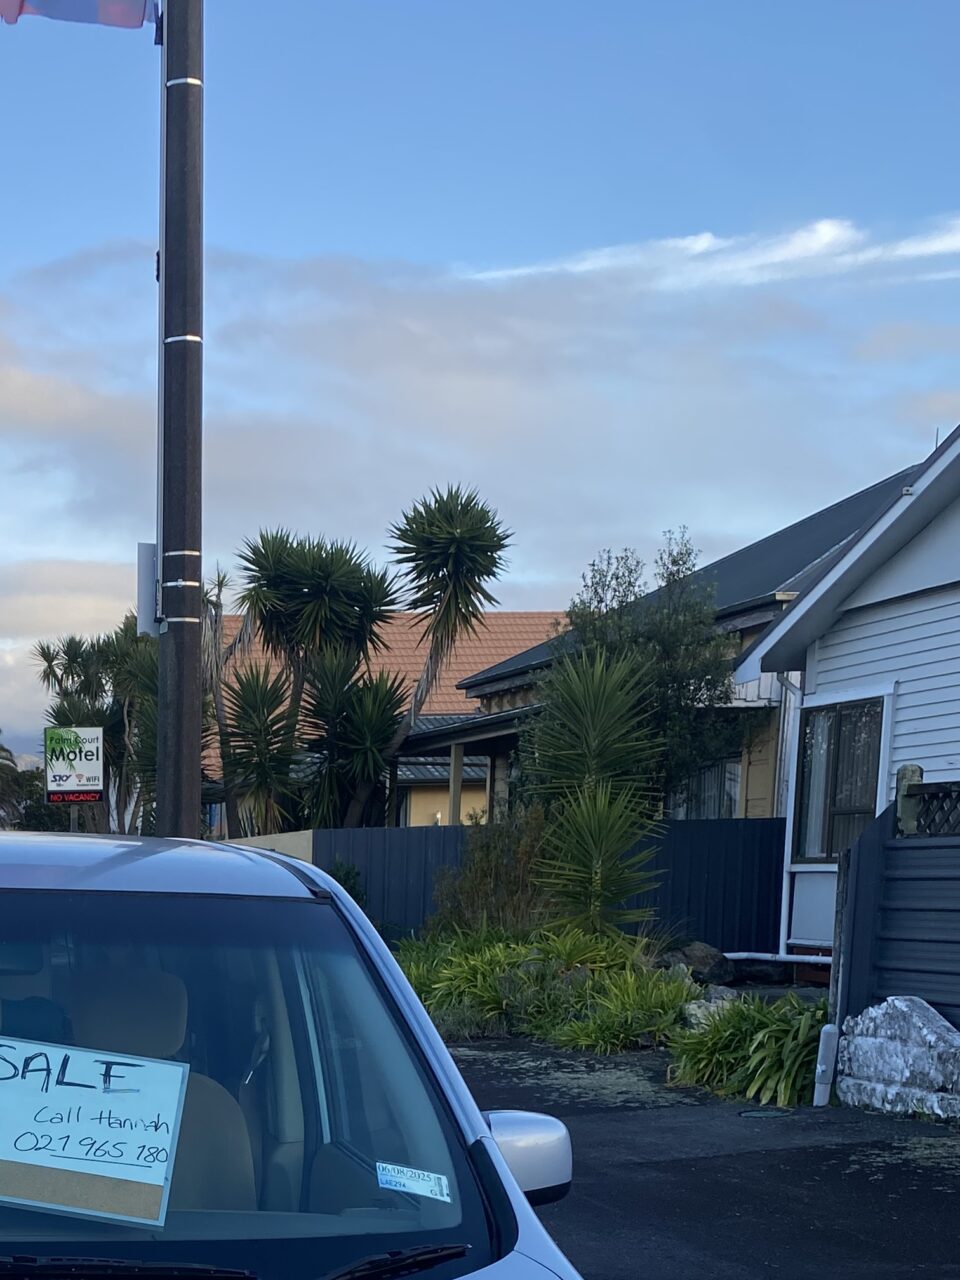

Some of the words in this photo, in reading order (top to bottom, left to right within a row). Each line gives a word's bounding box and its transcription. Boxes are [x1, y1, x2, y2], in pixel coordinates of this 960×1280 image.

[49, 736, 72, 744] Palm
[75, 736, 99, 744] Court
[50, 746, 99, 761] Motel
[51, 774, 72, 783] SKY
[50, 793, 62, 801] NO
[64, 793, 100, 801] VACANCY
[33, 1105, 81, 1124] Call
[14, 1131, 70, 1152] 021
[78, 1136, 128, 1158] 965
[136, 1145, 169, 1163] 180
